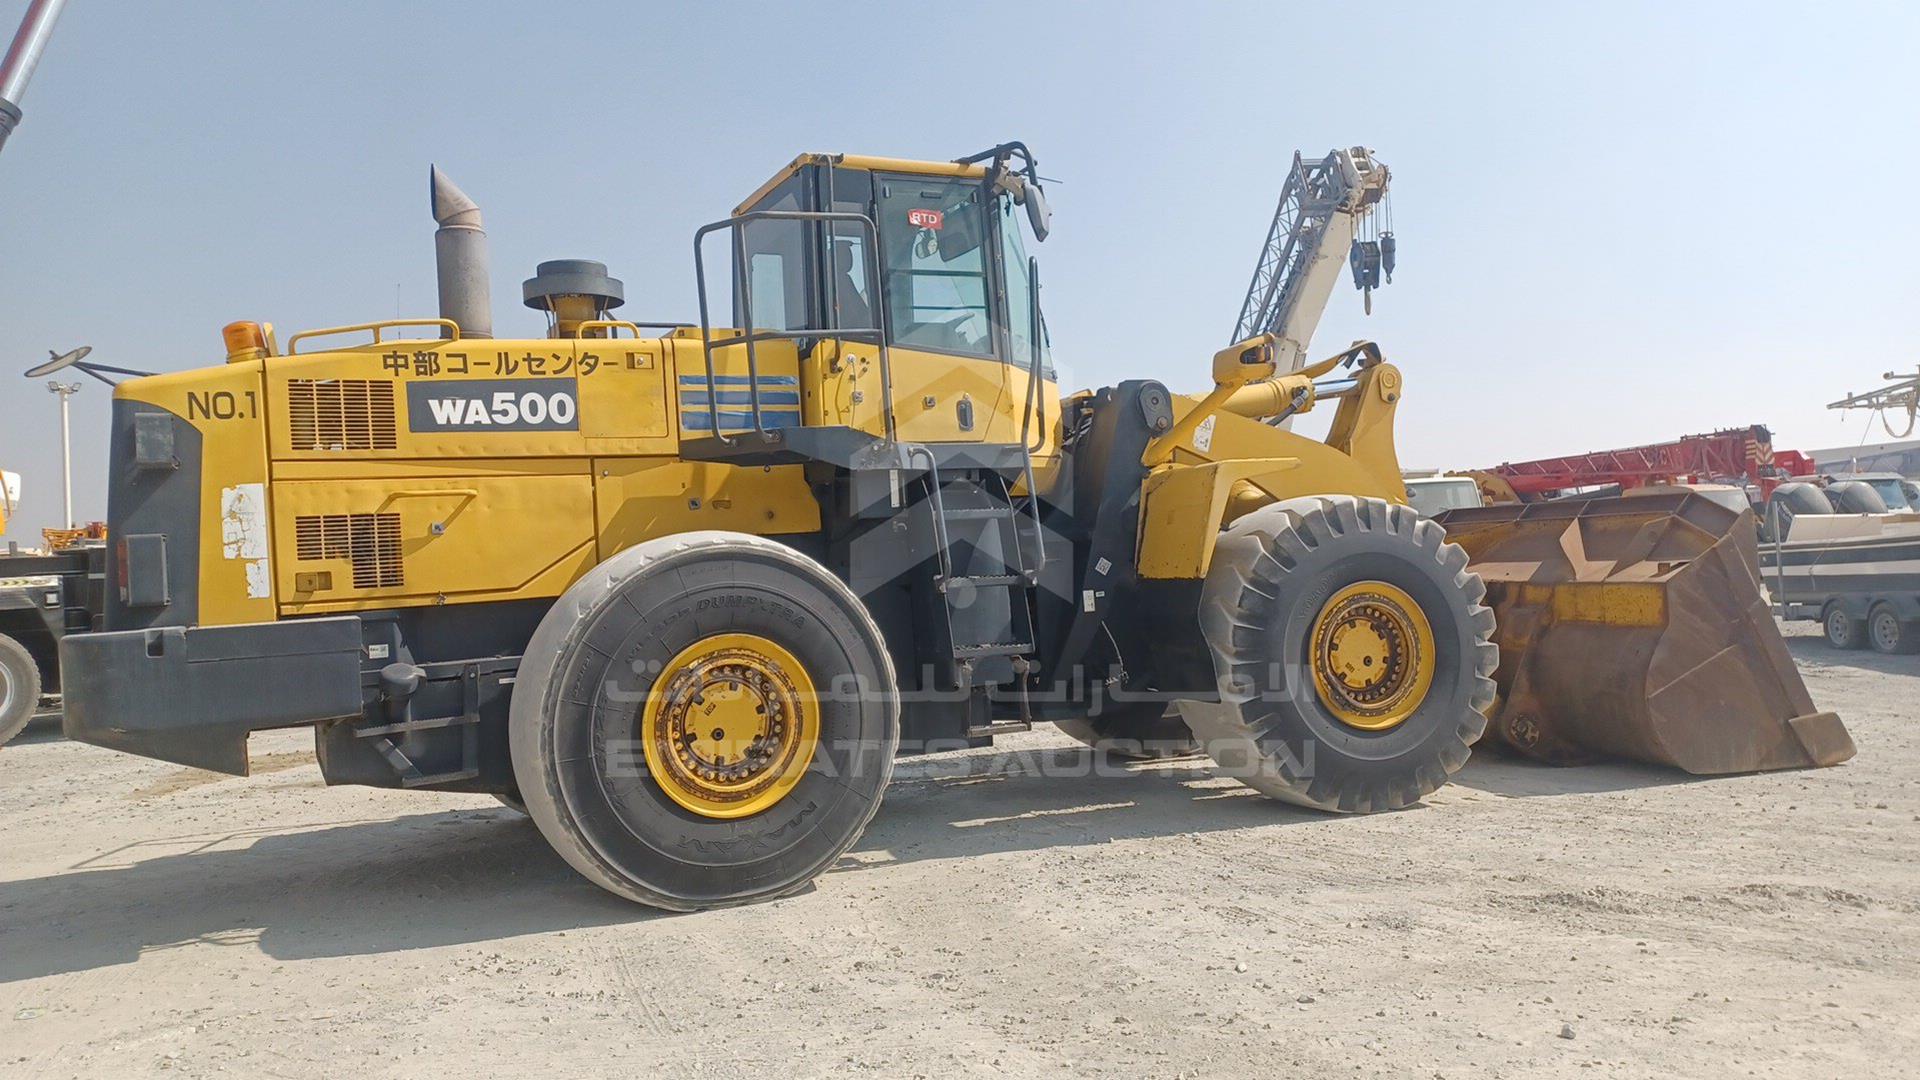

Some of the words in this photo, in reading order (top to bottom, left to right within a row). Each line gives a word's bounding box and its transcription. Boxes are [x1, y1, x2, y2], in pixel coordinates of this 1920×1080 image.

[911, 211, 938, 225] RTD
[382, 350, 619, 377] 中部コールセンター
[187, 390, 257, 420] NO.1
[428, 391, 576, 425] WA500
